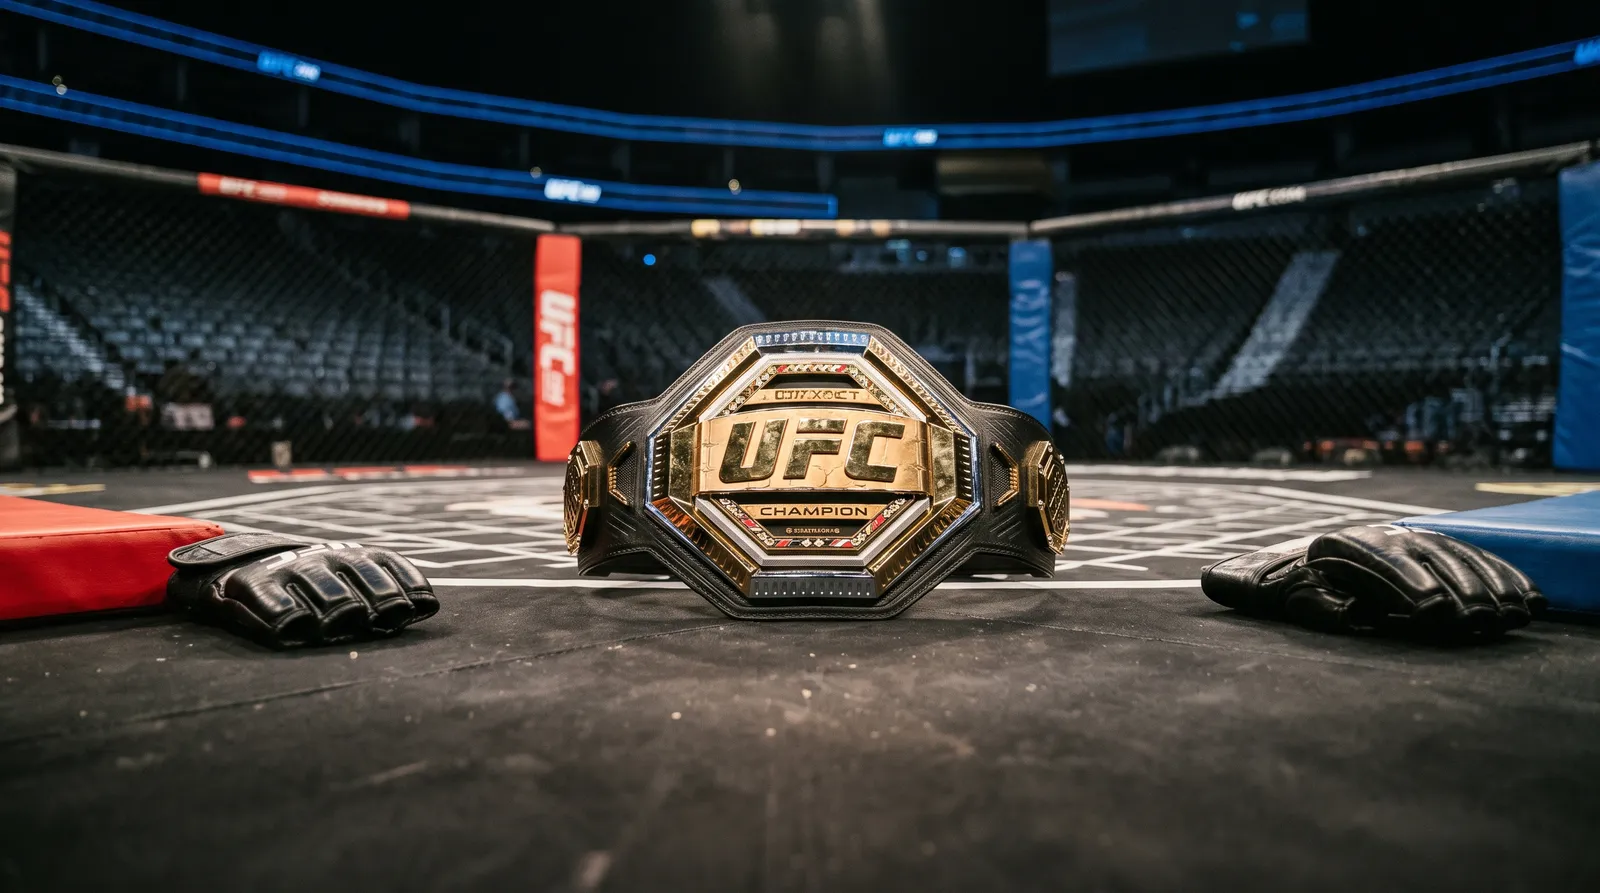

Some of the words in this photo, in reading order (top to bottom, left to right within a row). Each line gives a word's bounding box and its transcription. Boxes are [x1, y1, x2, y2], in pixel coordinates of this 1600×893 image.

[540, 290, 576, 376] UFC
[719, 418, 906, 483] UFC
[760, 506, 868, 516] CHAMPION
